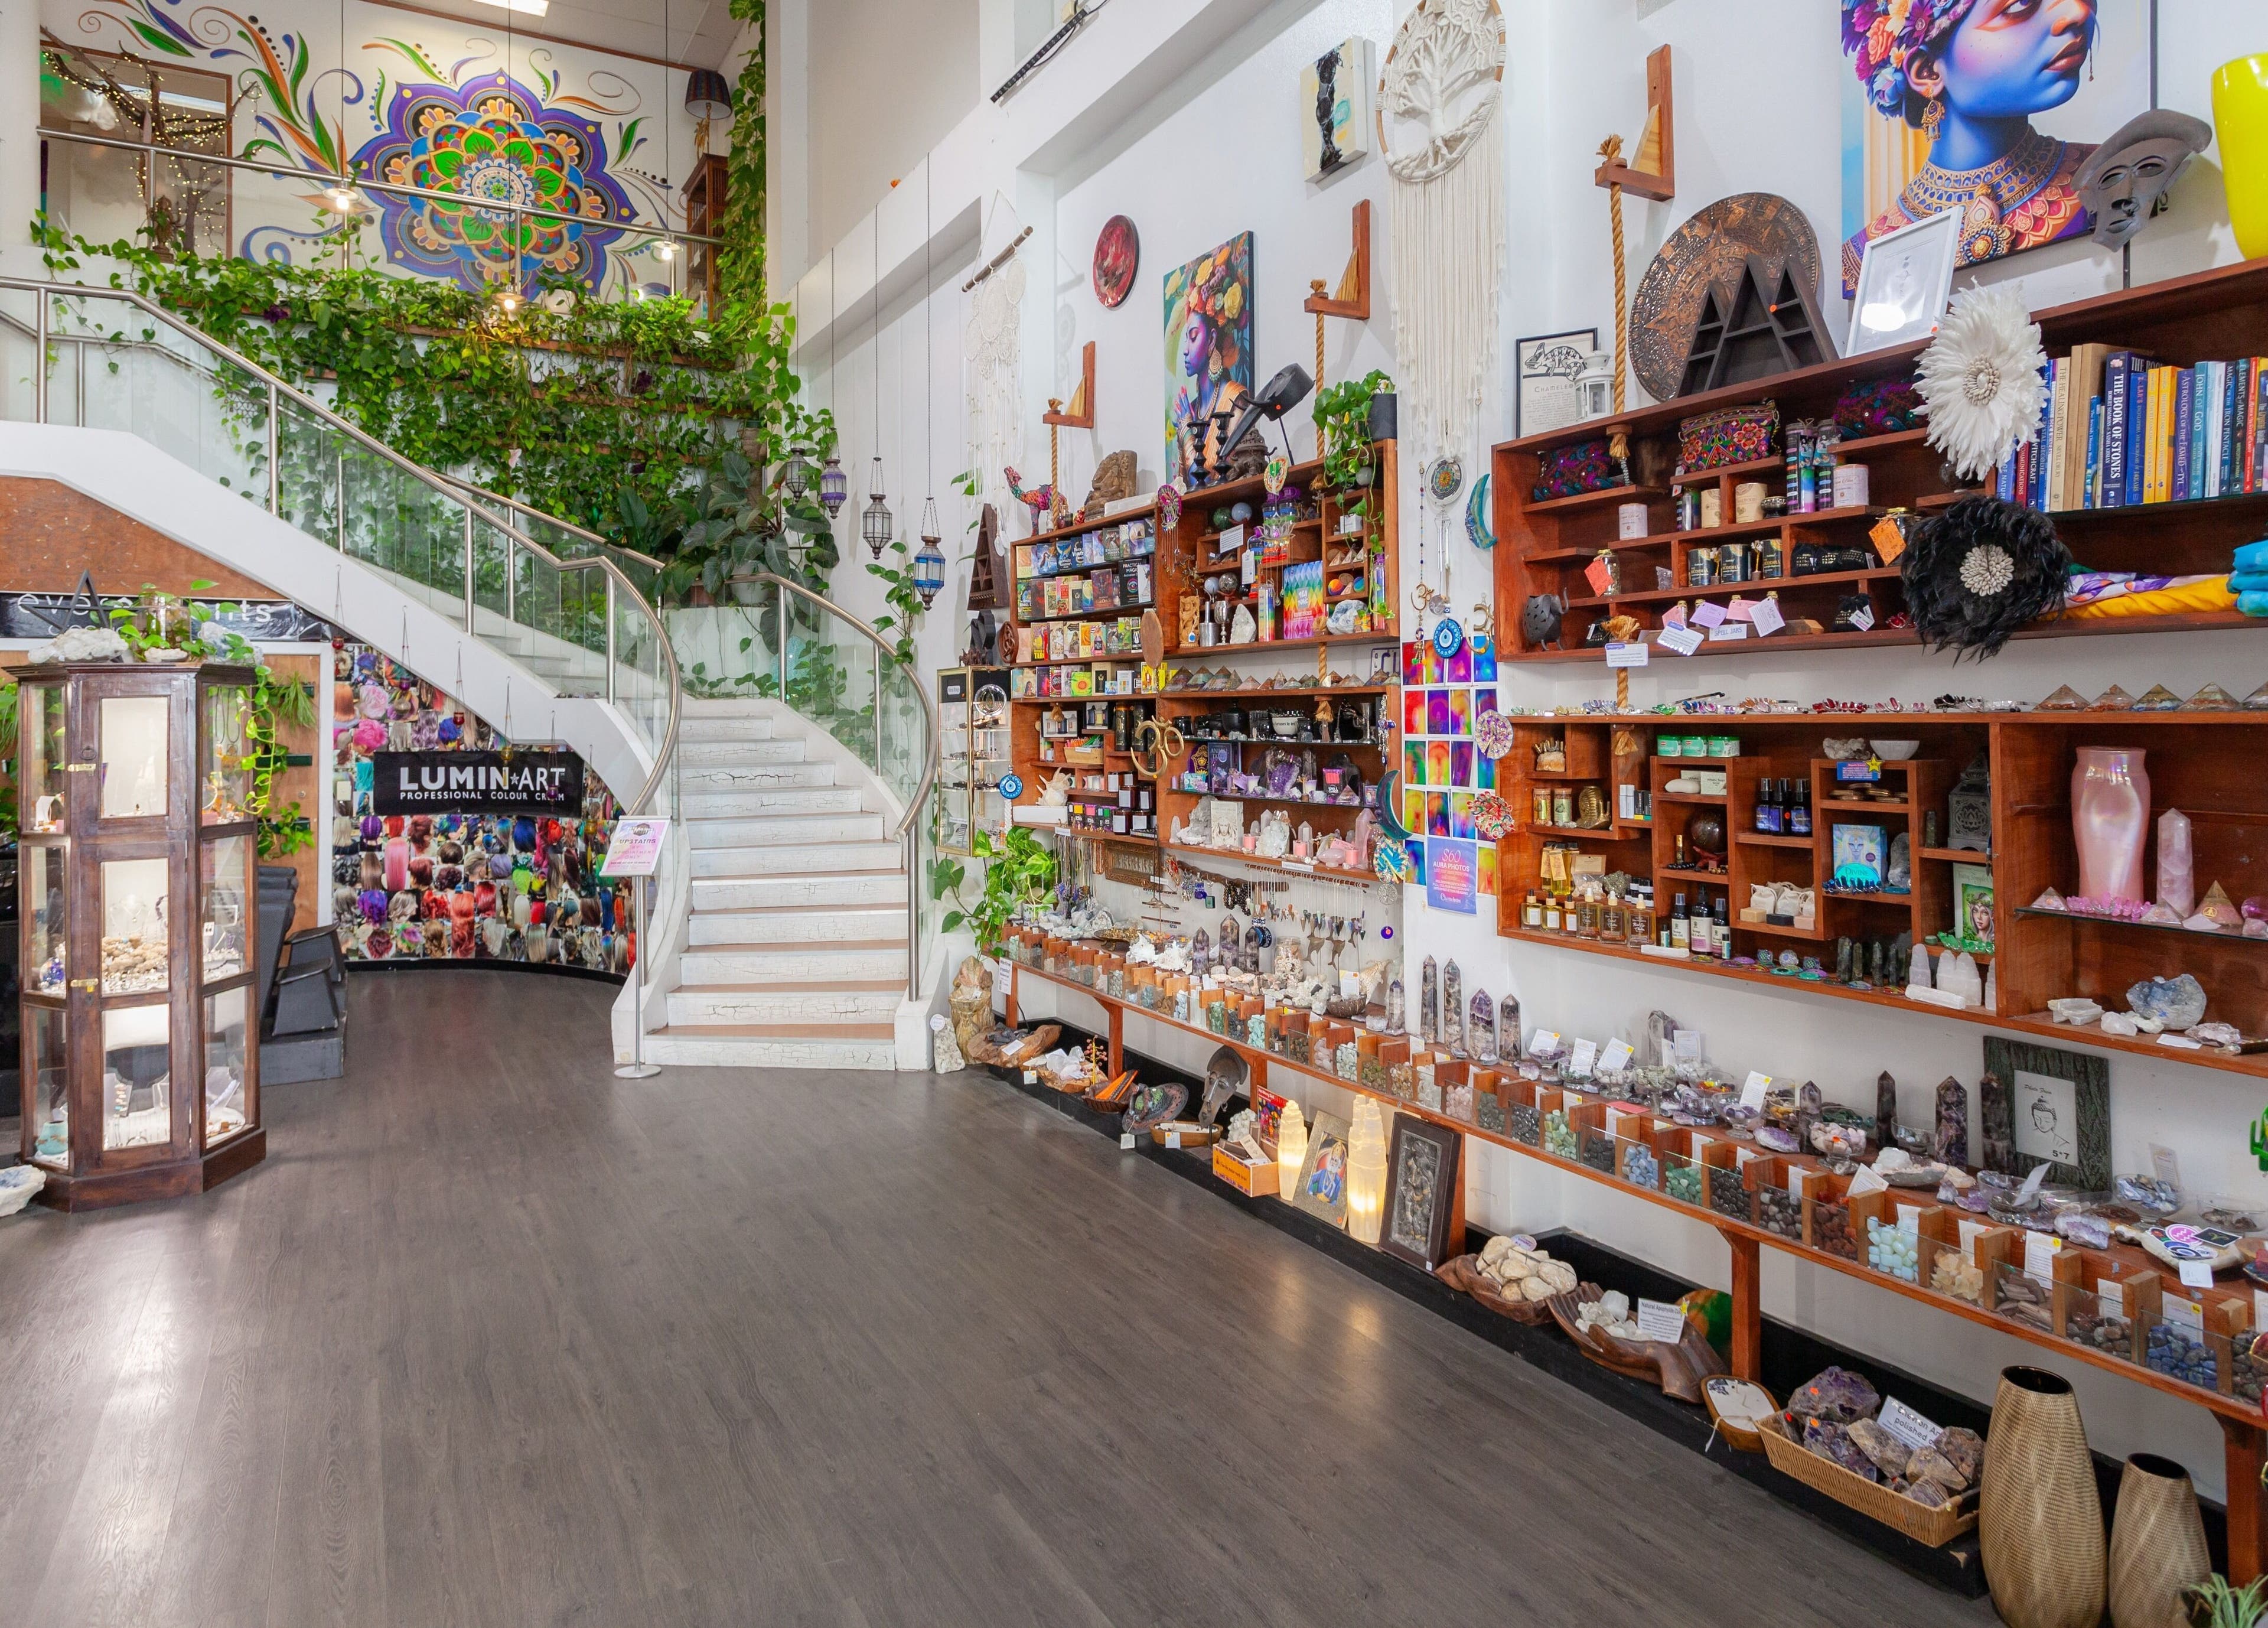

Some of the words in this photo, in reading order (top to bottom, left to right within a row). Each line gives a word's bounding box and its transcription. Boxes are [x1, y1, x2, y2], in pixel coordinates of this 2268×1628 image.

[2132, 357, 2143, 372] THE
[2114, 374, 2124, 395] THE
[2195, 374, 2204, 396] JOHN
[2225, 366, 2233, 389] MAGIC
[2237, 363, 2246, 400] ELEMENTS
[2180, 376, 2190, 419] ASTROLOGY
[2195, 399, 2202, 409] OF
[2113, 396, 2123, 425] BOOK
[2194, 411, 2203, 431] GOD
[2236, 404, 2244, 427] MAGIC
[2112, 426, 2122, 439] OF
[2222, 427, 2230, 459] PENTACLE
[2110, 441, 2122, 478] STONES
[2178, 442, 2188, 467] FAMED
[400, 767, 509, 790] LUMIN
[518, 767, 565, 791] ART
[400, 791, 482, 800] PROFESSIONAL
[491, 792, 528, 800] COLOUR
[1448, 863, 1470, 872] PHOTOS
[1845, 867, 1869, 877] DIVINE
[1898, 1406, 1928, 1429] Chevron
[1894, 1418, 1928, 1441] polished
